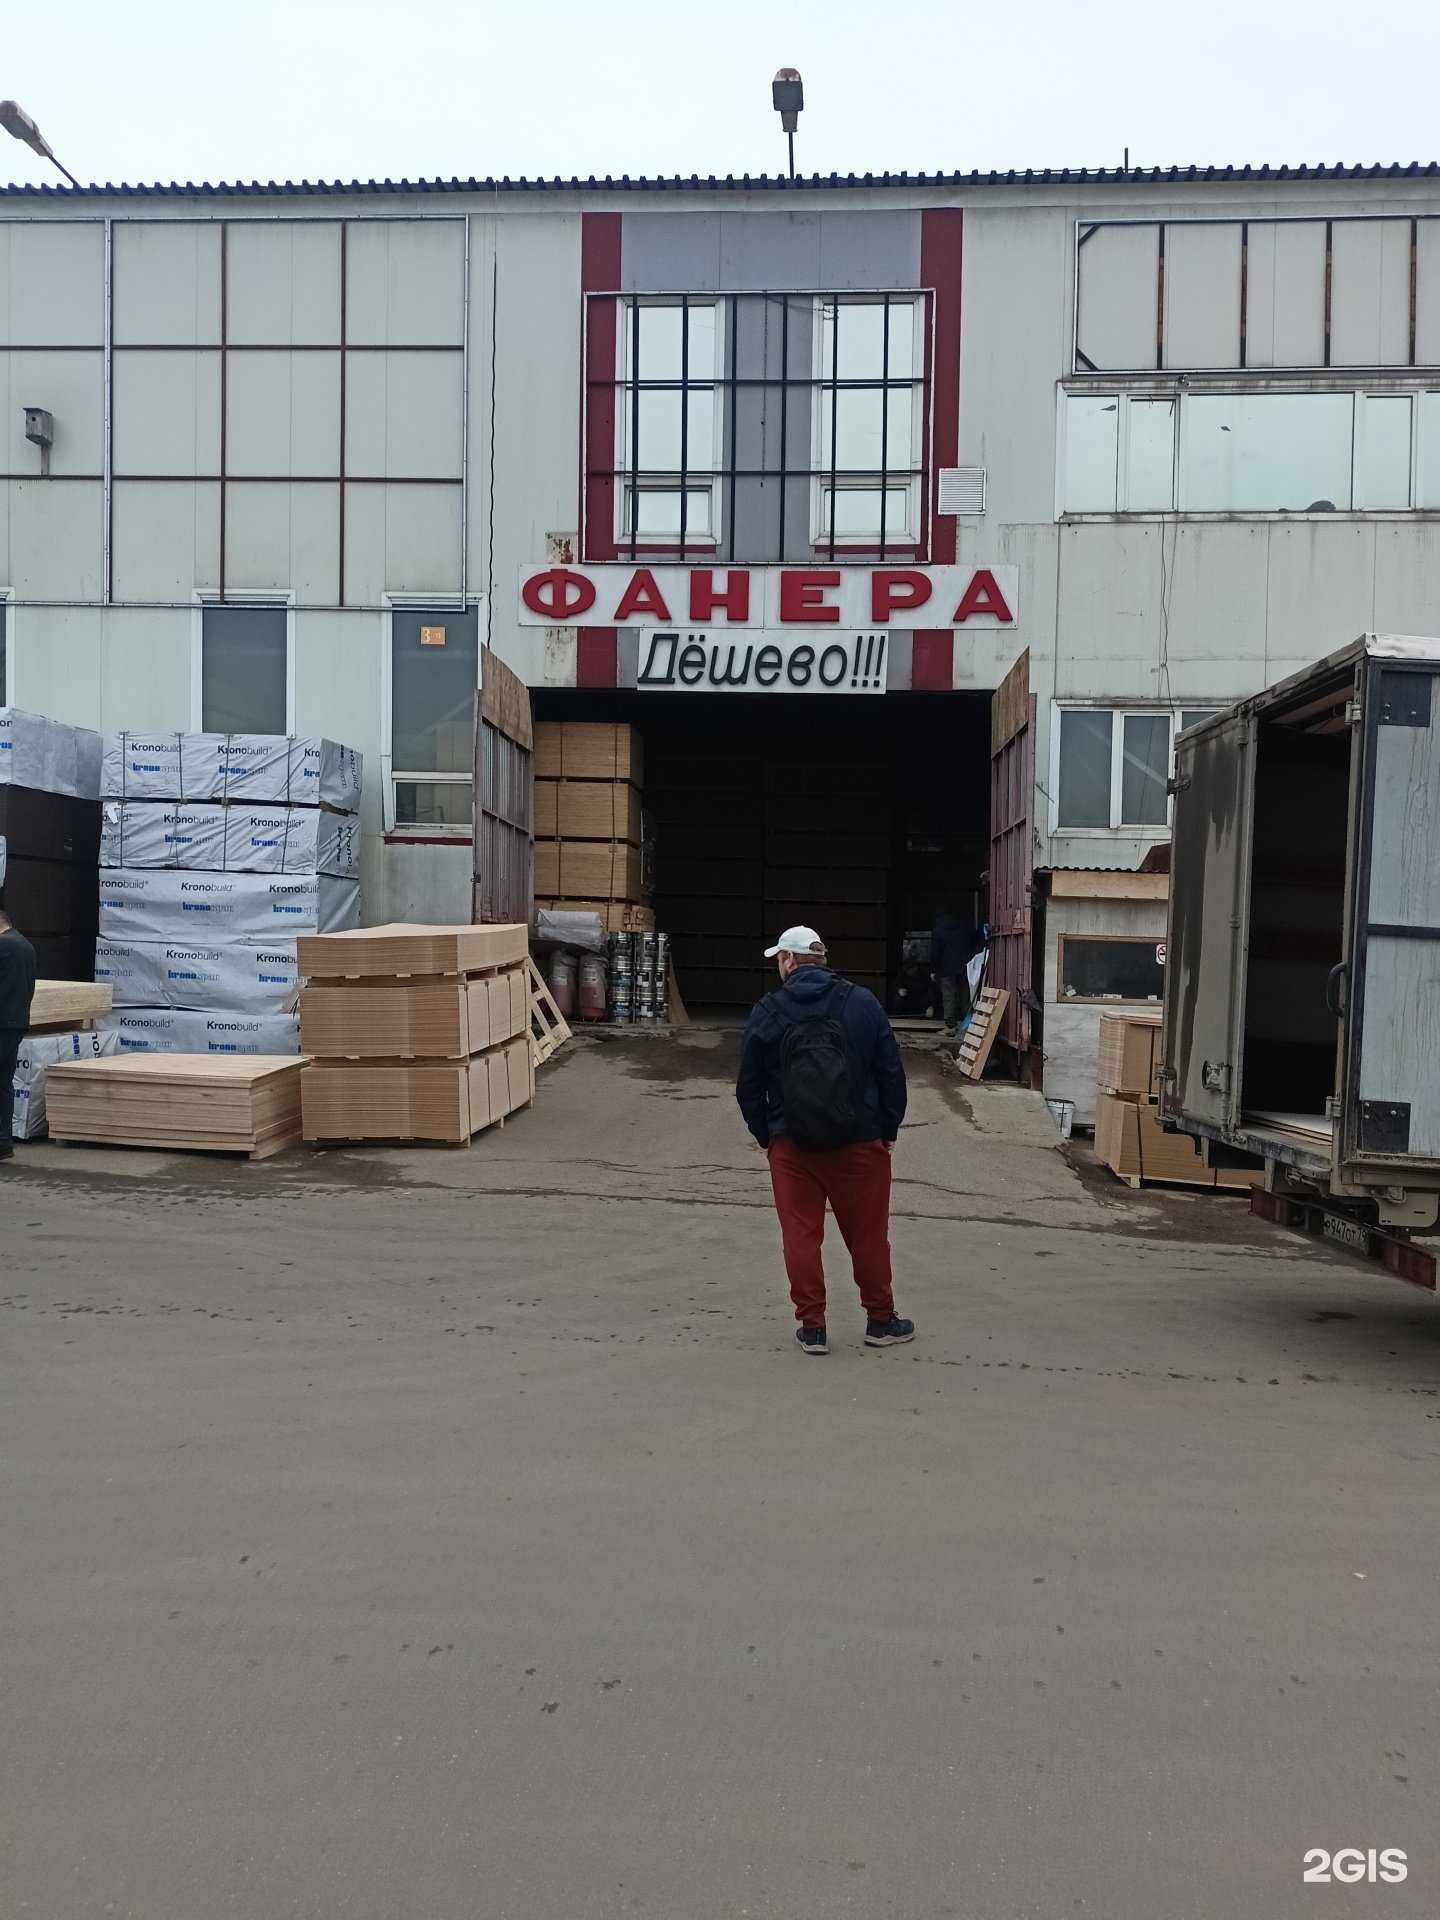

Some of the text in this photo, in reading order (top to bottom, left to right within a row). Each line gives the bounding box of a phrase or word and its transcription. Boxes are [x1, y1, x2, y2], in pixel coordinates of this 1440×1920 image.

[522, 568, 1014, 622] ФАНЕРА
[638, 633, 886, 688] Дёшево!!!
[207, 1021, 258, 1032] Kronobuild
